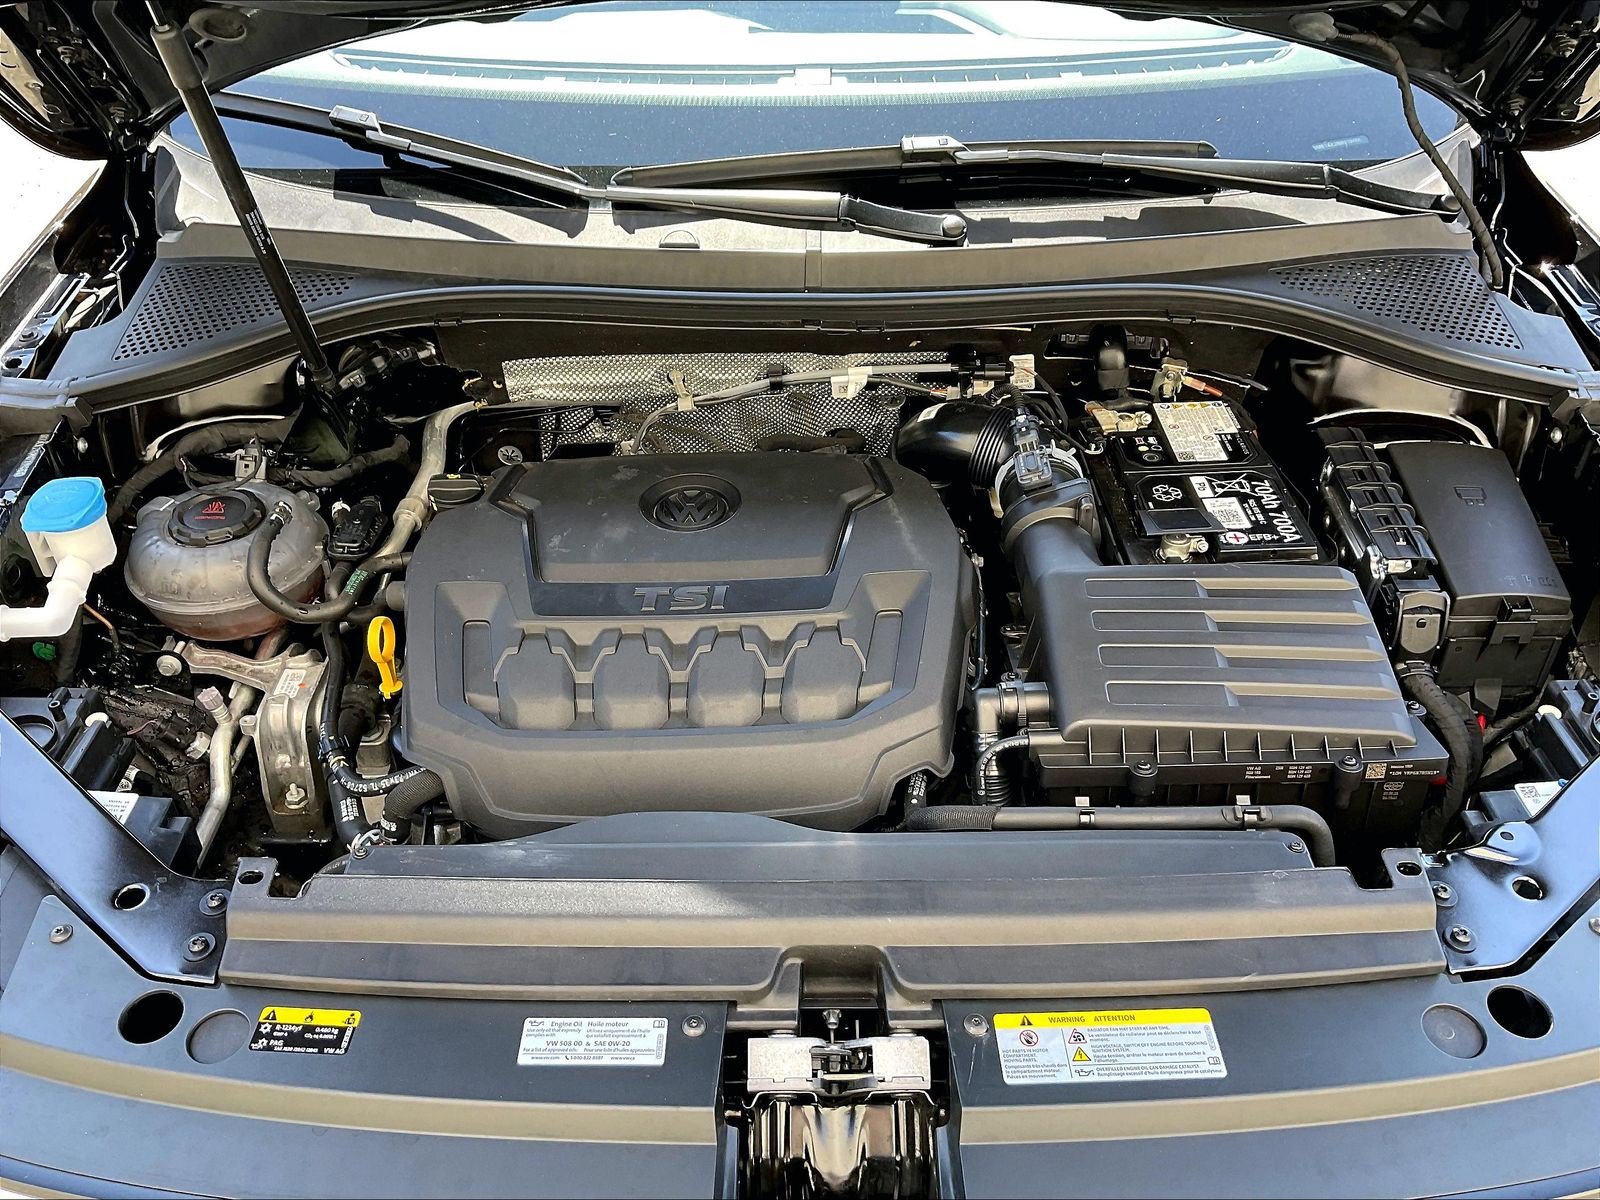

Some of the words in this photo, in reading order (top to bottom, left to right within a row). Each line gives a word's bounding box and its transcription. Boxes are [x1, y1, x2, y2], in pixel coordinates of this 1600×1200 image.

[1194, 482, 1207, 492] Pb
[1251, 480, 1283, 509] 70Ah
[1268, 511, 1303, 543] 700A
[1248, 533, 1281, 542] EFB+
[633, 585, 730, 612] TSI
[587, 1020, 605, 1028] Huile
[1048, 1016, 1086, 1024] WARNING
[1094, 1014, 1136, 1022] ATTENTION
